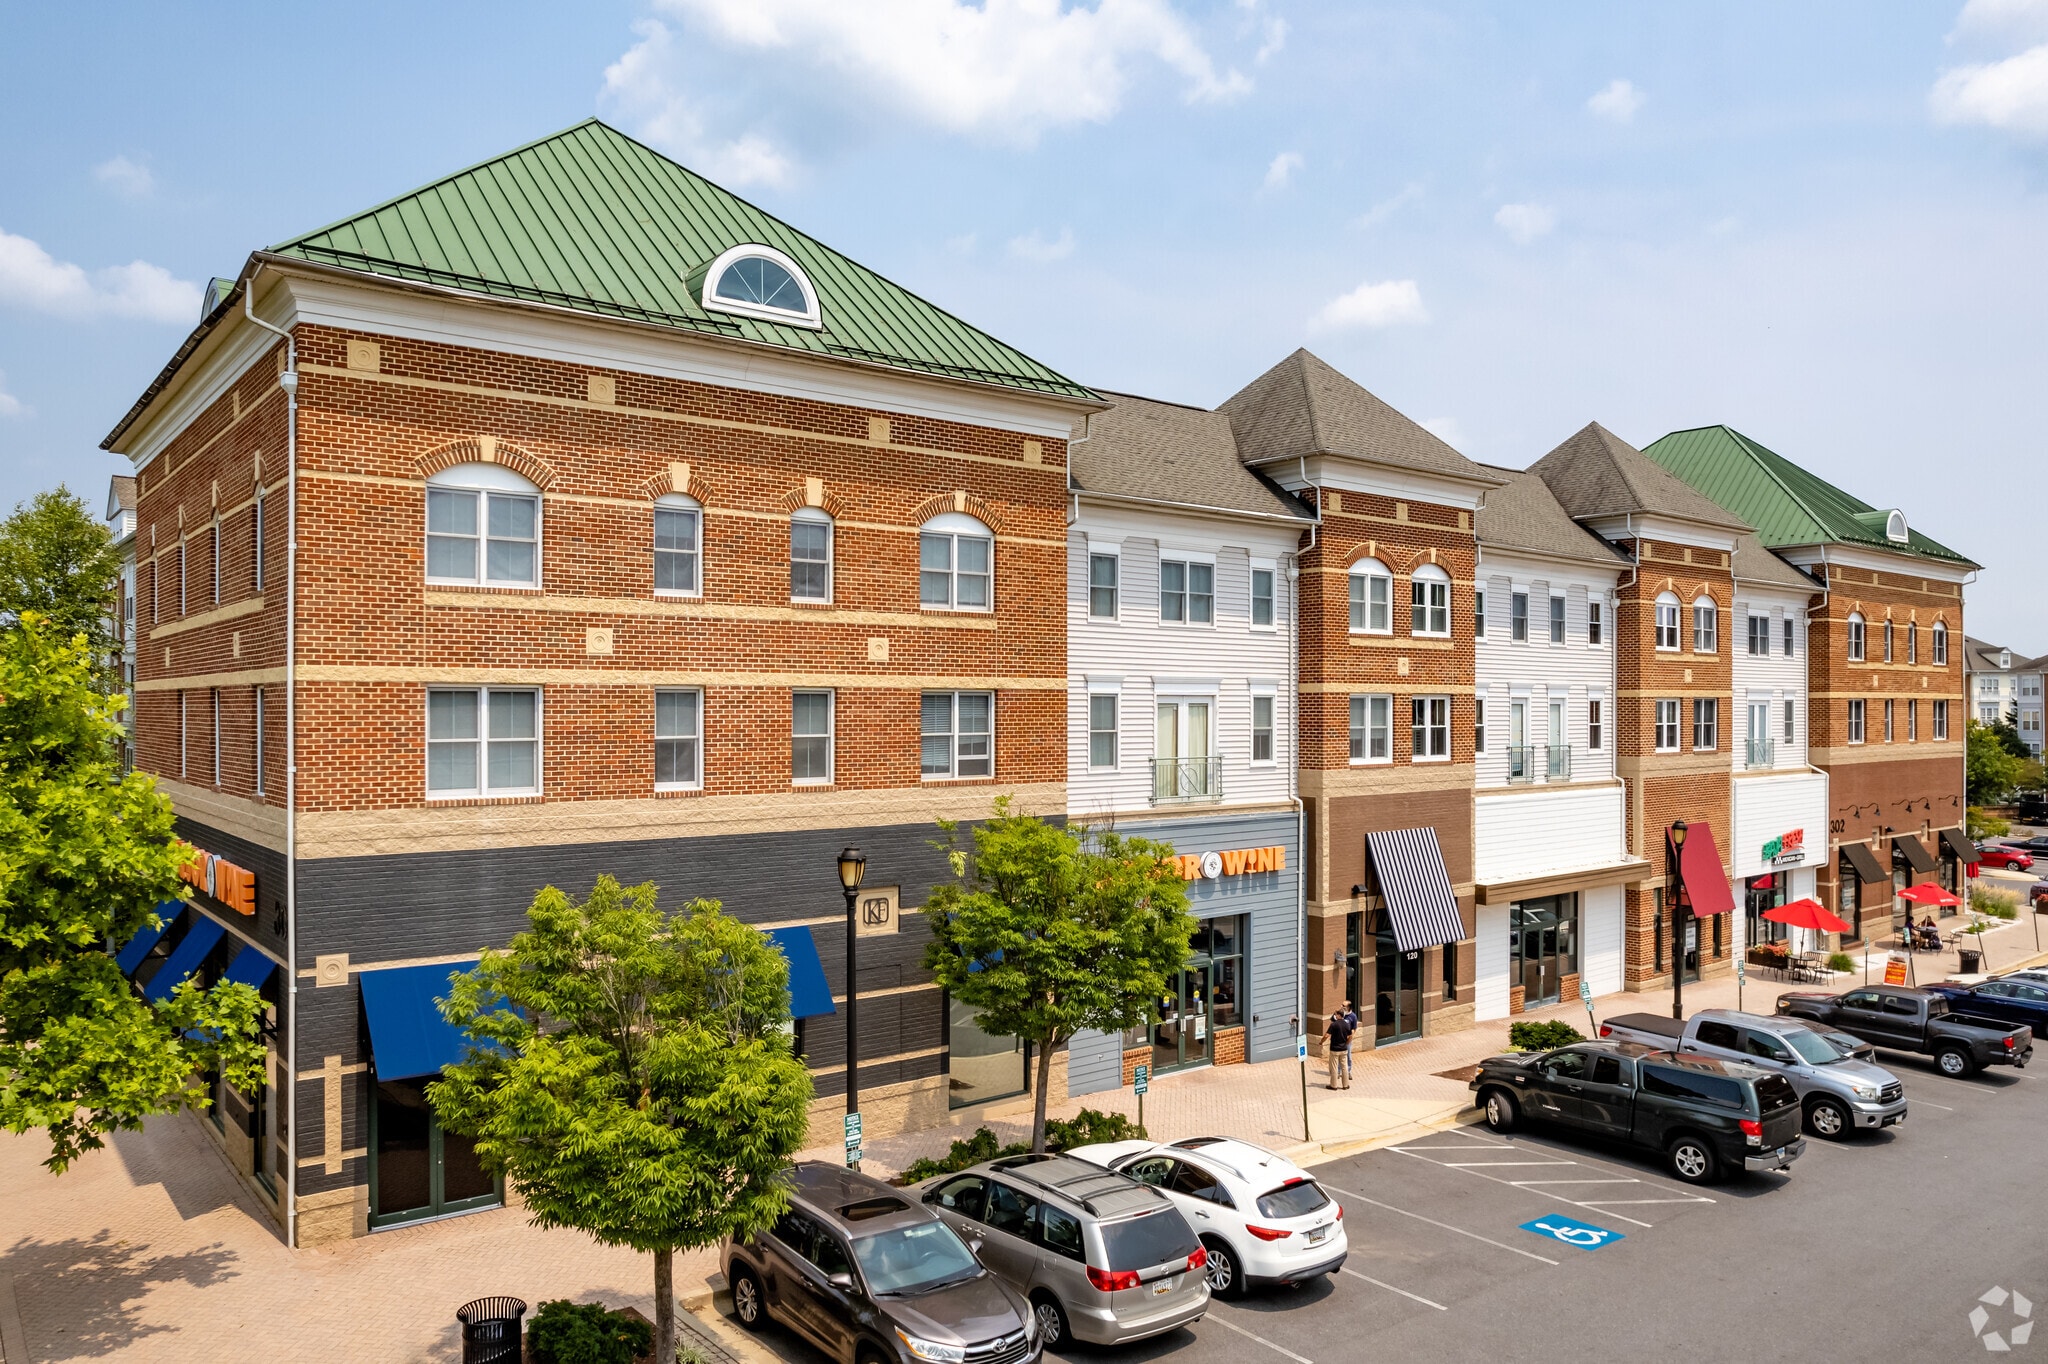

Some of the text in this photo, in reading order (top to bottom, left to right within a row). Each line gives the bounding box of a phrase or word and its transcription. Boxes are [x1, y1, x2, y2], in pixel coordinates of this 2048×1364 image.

[1830, 819, 1845, 833] 302
[1220, 846, 1286, 876] WINE
[1406, 951, 1418, 960] 120
